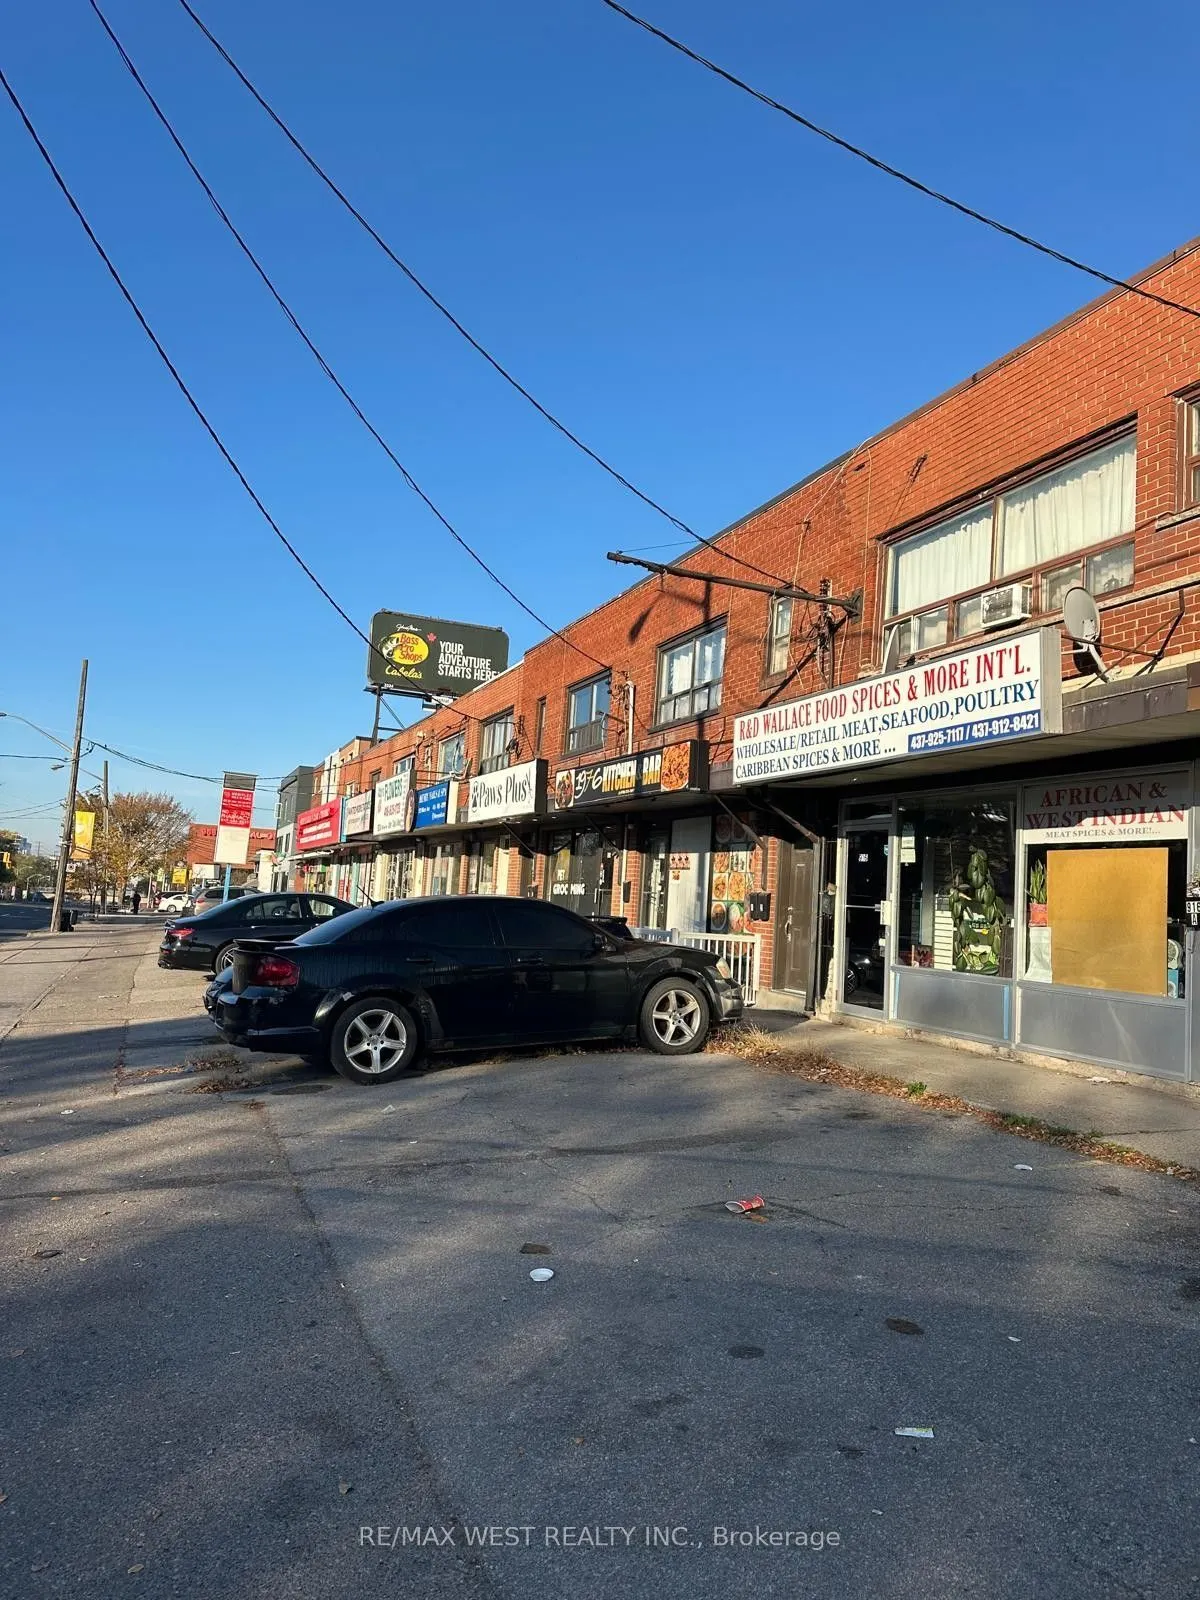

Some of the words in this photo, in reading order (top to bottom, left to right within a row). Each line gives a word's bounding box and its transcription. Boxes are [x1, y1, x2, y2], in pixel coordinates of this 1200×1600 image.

[438, 653, 492, 671] ADVENTURE
[439, 640, 464, 655] YOUR
[438, 664, 472, 679] STARTS
[739, 716, 760, 742] R&D
[763, 702, 812, 736] WALLACE
[815, 693, 847, 724] FOOD
[851, 678, 900, 715] SPICES
[907, 674, 918, 702] &
[924, 658, 970, 698] MORE
[975, 644, 1032, 684] INT'L.
[735, 724, 840, 761] WHOLESALE/RETAIL
[910, 725, 964, 750] 437-925-7117
[971, 712, 1040, 739] 437-912-8421
[735, 755, 791, 779] CARIBBEAN
[792, 748, 829, 770] SPICES
[831, 750, 841, 763] &
[843, 738, 881, 761] MORE
[479, 781, 503, 808] Paws
[505, 773, 527, 805] Plus
[574, 767, 603, 800] 1976
[602, 759, 638, 793] KITCHEN
[642, 754, 662, 786] BAR
[1040, 781, 1143, 808] AFRICAN
[1149, 781, 1168, 799] &
[1026, 810, 1087, 829] WEST
[1090, 803, 1186, 828] INDIAN
[1045, 830, 1072, 839] MEAT
[1072, 828, 1107, 838] SPICES
[1108, 828, 1117, 836] &
